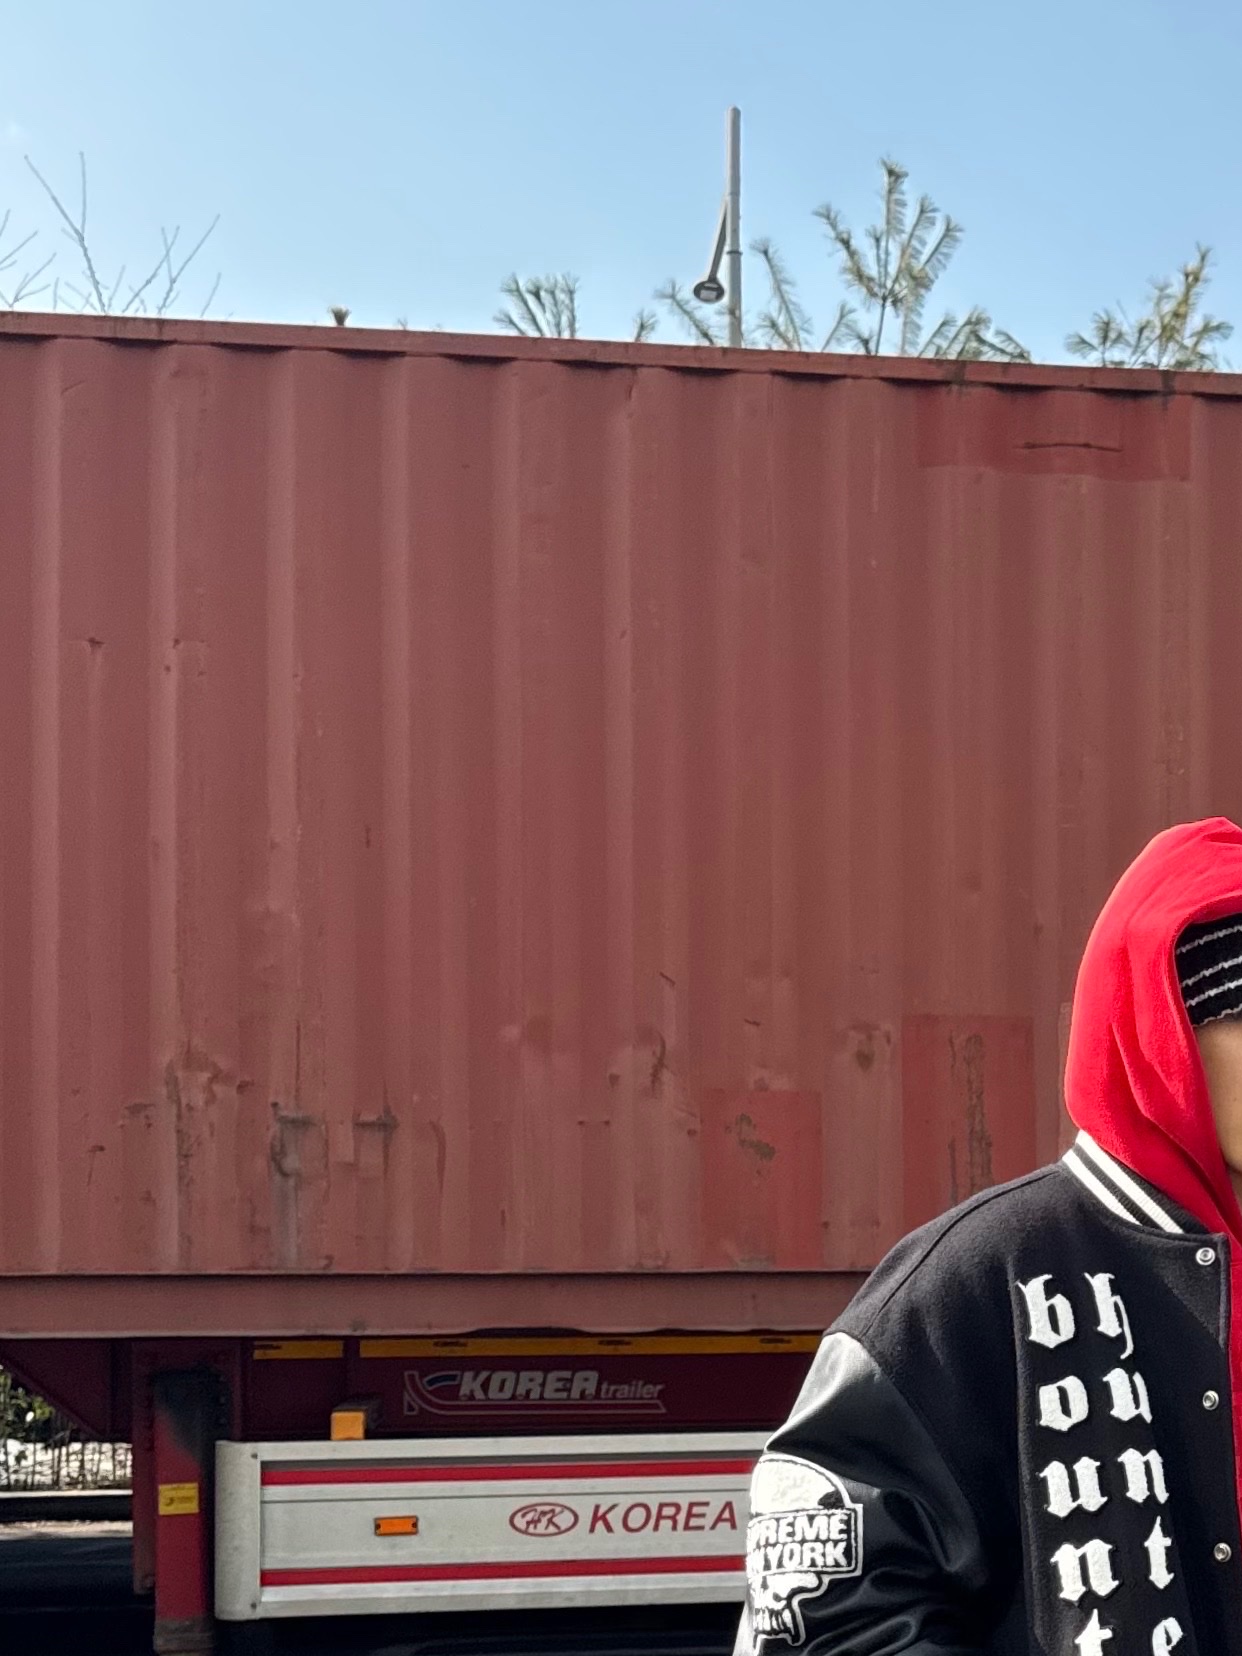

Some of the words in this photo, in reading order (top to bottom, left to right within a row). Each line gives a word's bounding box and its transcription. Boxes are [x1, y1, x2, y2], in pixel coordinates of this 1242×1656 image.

[458, 1370, 599, 1400] KOREA
[601, 1380, 665, 1400] trailer
[588, 1500, 738, 1534] KOREA
